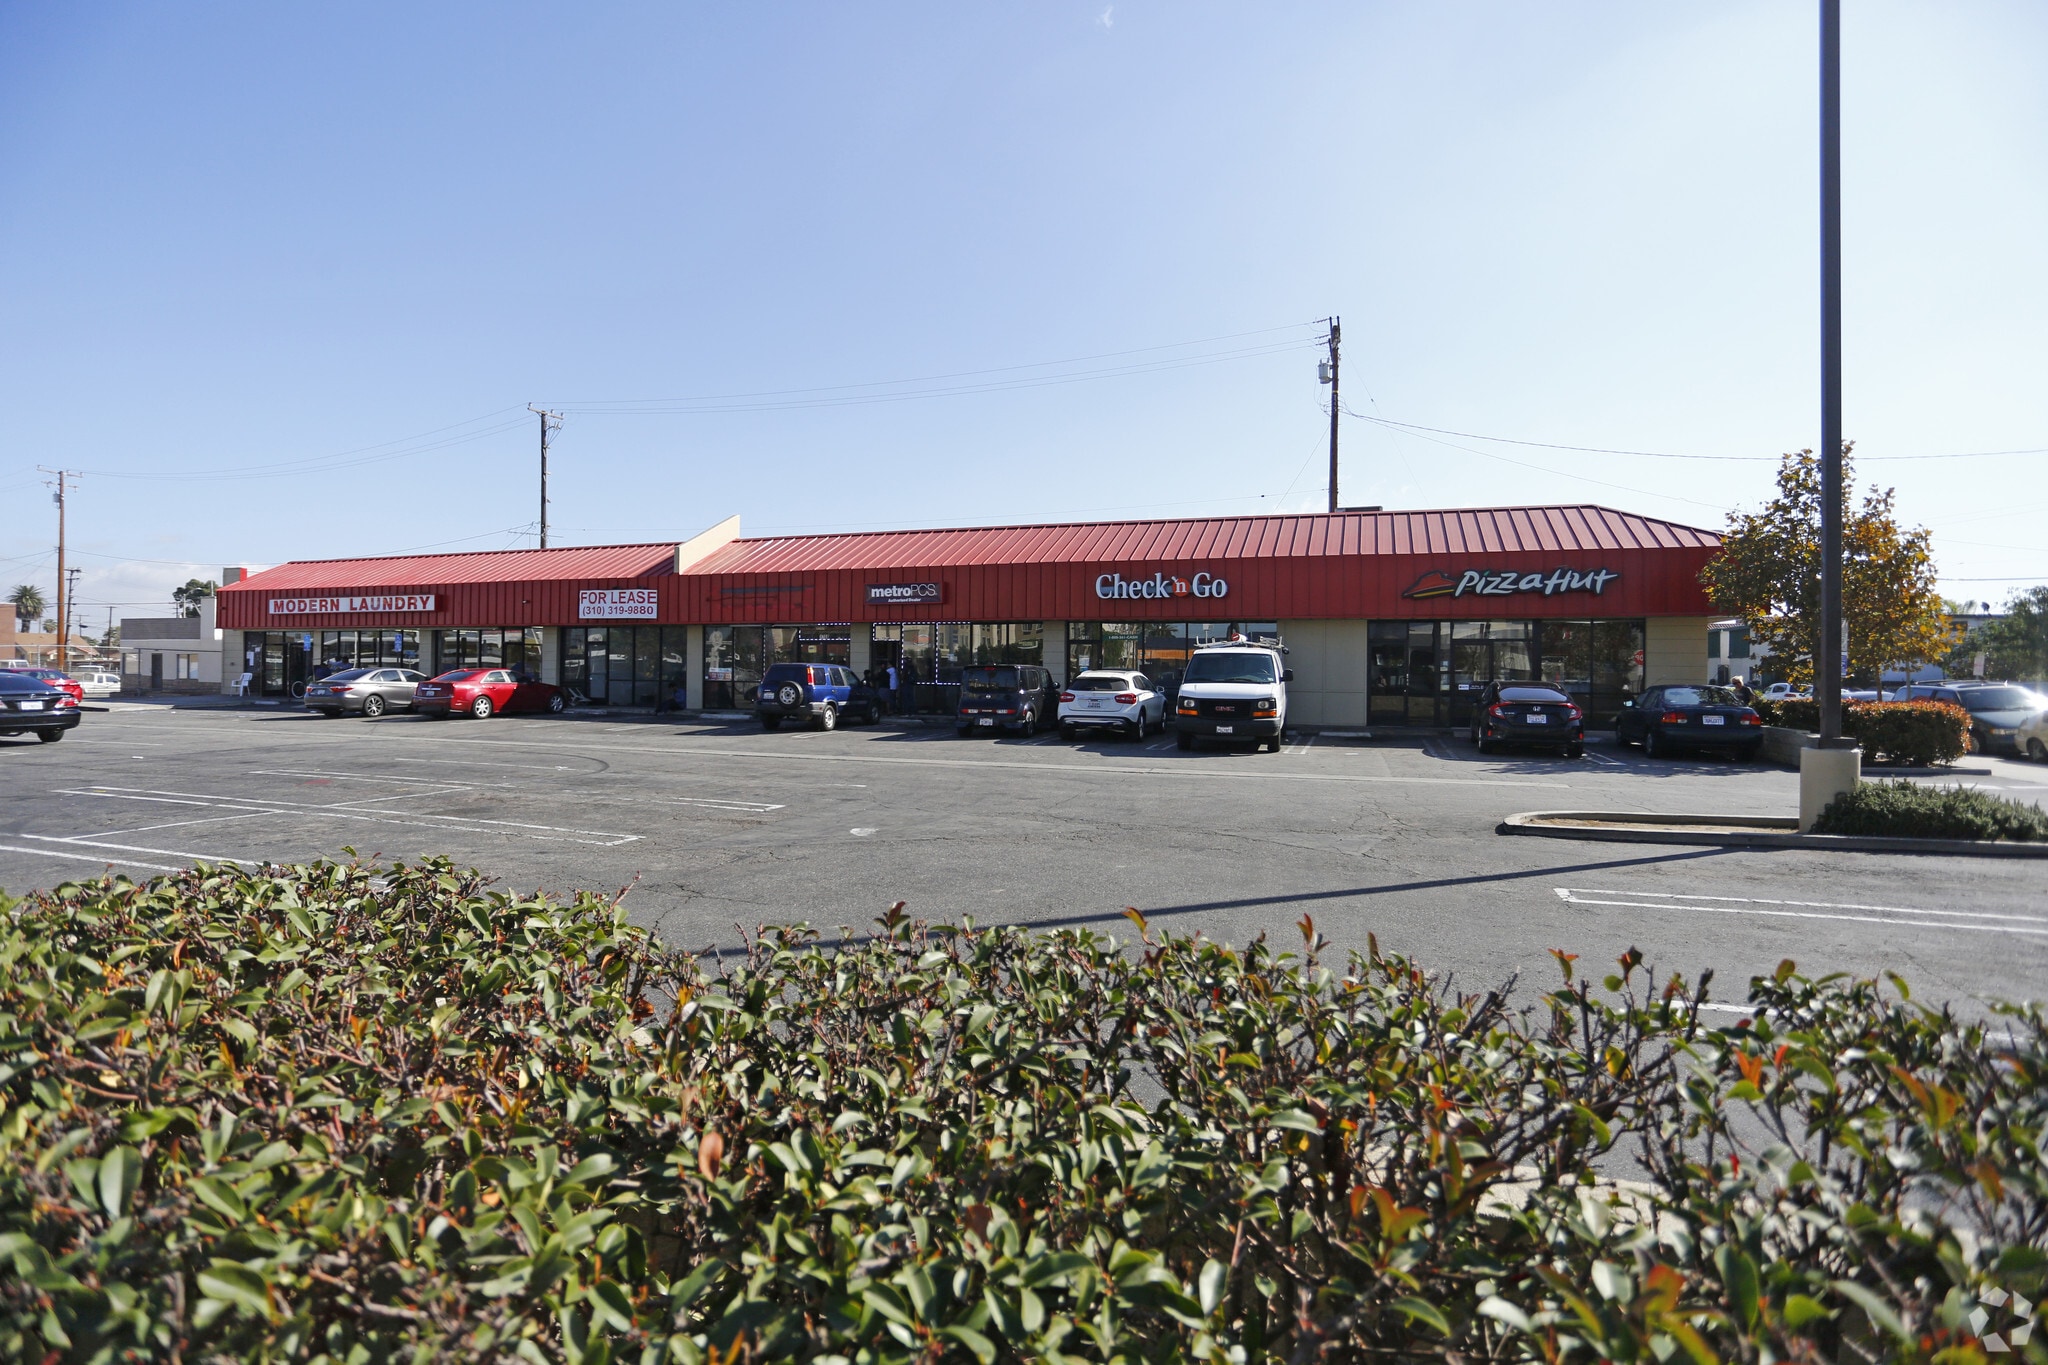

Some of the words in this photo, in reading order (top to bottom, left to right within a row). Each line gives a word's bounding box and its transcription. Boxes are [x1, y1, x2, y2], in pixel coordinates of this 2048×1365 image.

[871, 583, 936, 597] metroPCS
[1096, 572, 1170, 599] Check
[1192, 571, 1228, 598] Go
[1454, 569, 1544, 598] Pizza
[1544, 568, 1618, 596] Hut
[273, 598, 340, 613] MODERN
[349, 596, 430, 611] LAUNDRY
[581, 591, 607, 604] FOR
[611, 591, 657, 604] LEASE
[582, 606, 605, 616] (310)
[608, 606, 654, 615] 319-9880
